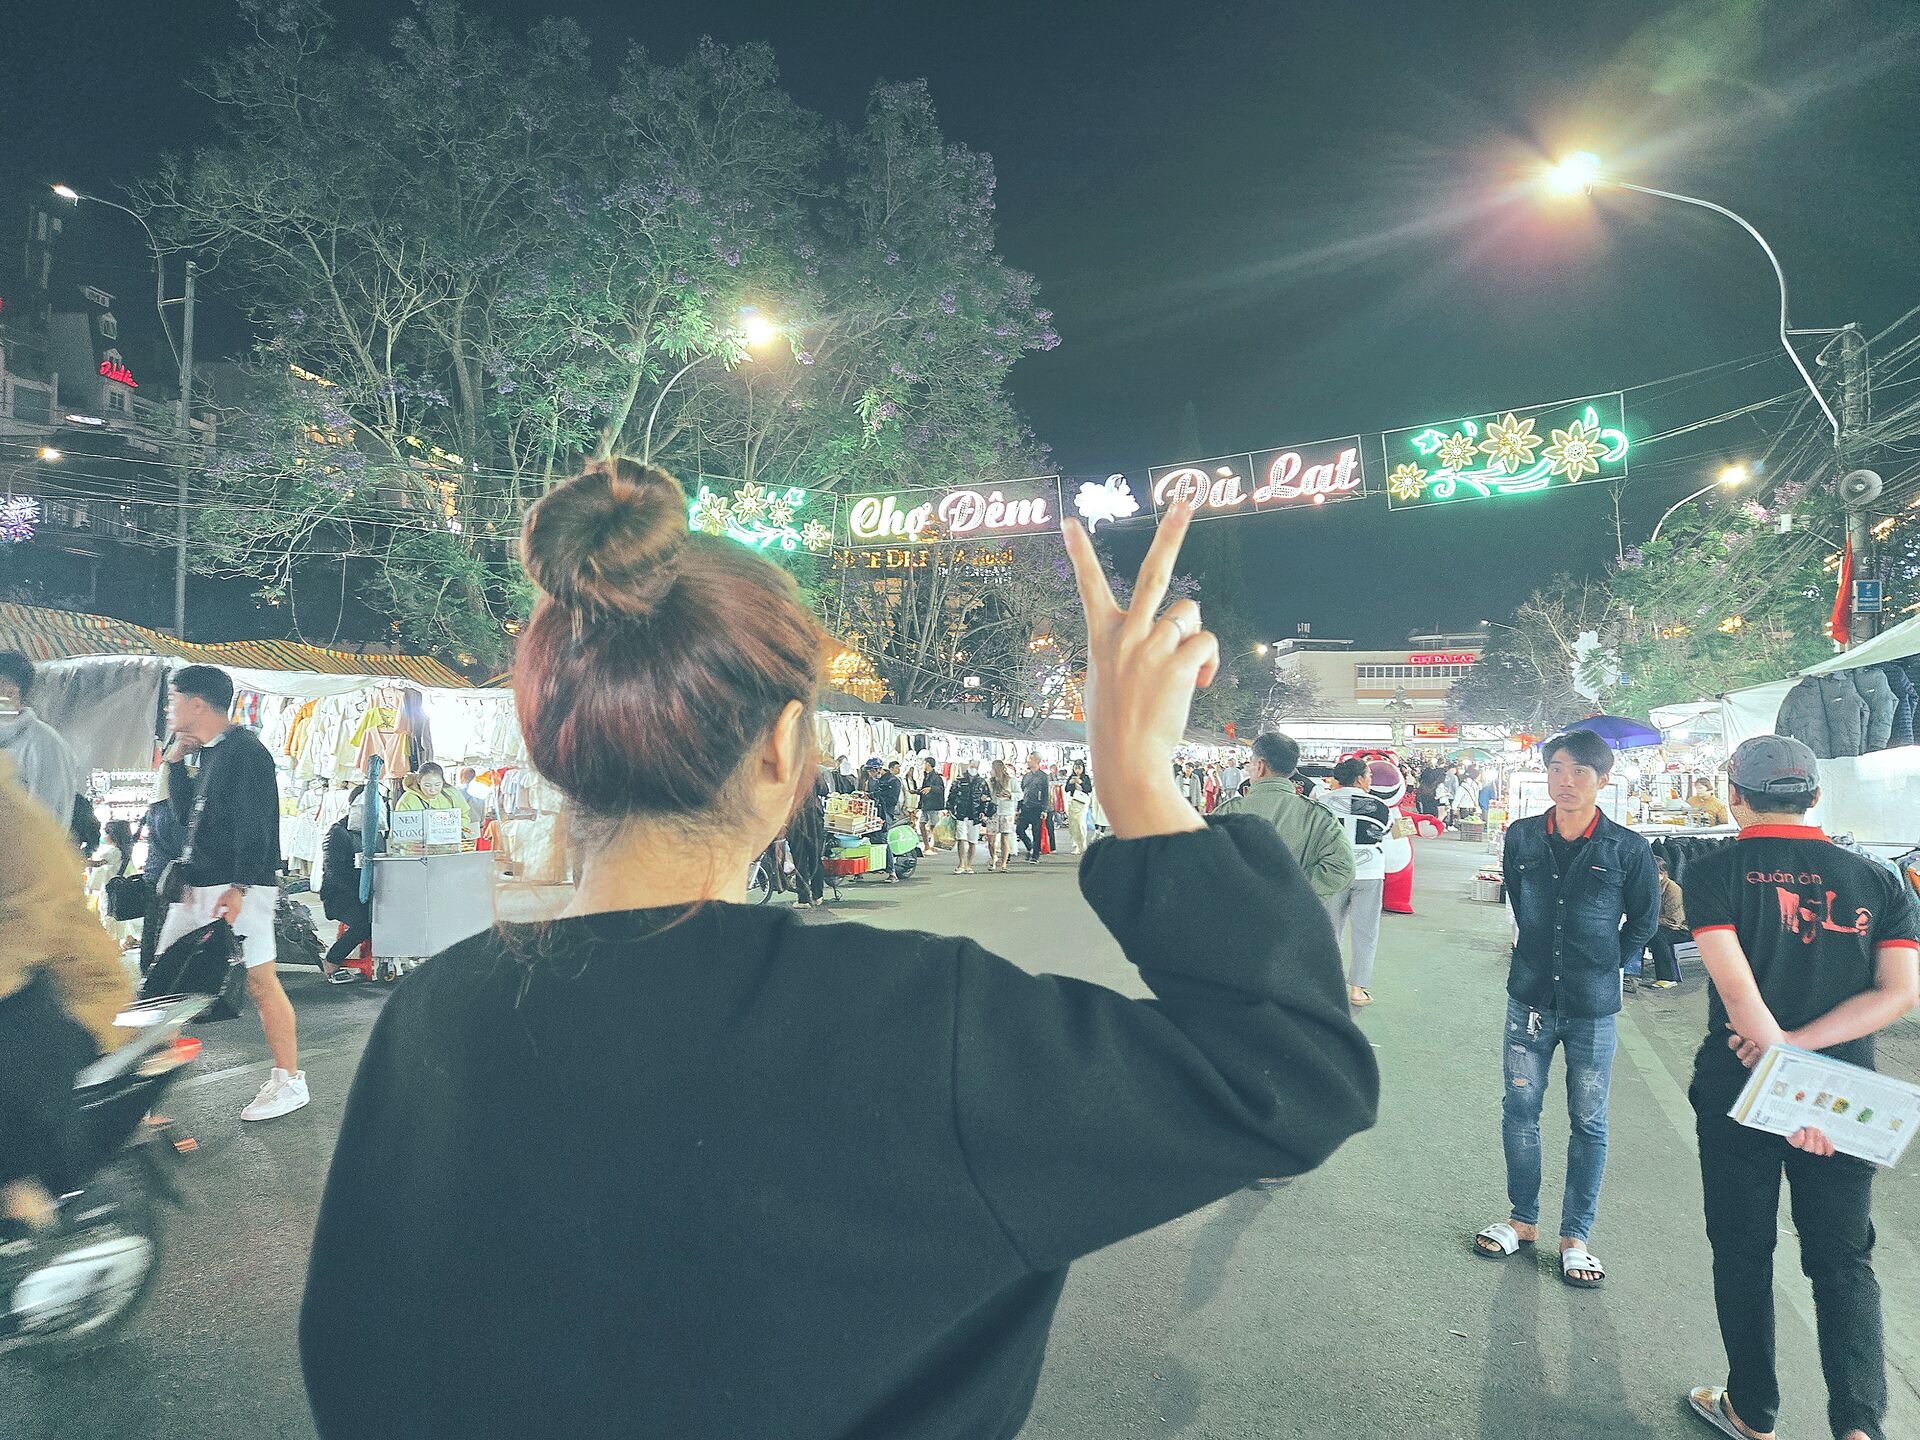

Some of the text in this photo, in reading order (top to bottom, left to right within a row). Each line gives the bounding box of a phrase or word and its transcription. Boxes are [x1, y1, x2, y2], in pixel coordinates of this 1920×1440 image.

[850, 448, 1362, 542] Chợ Đêm Đà Lạt
[1747, 869, 1795, 884] Quán
